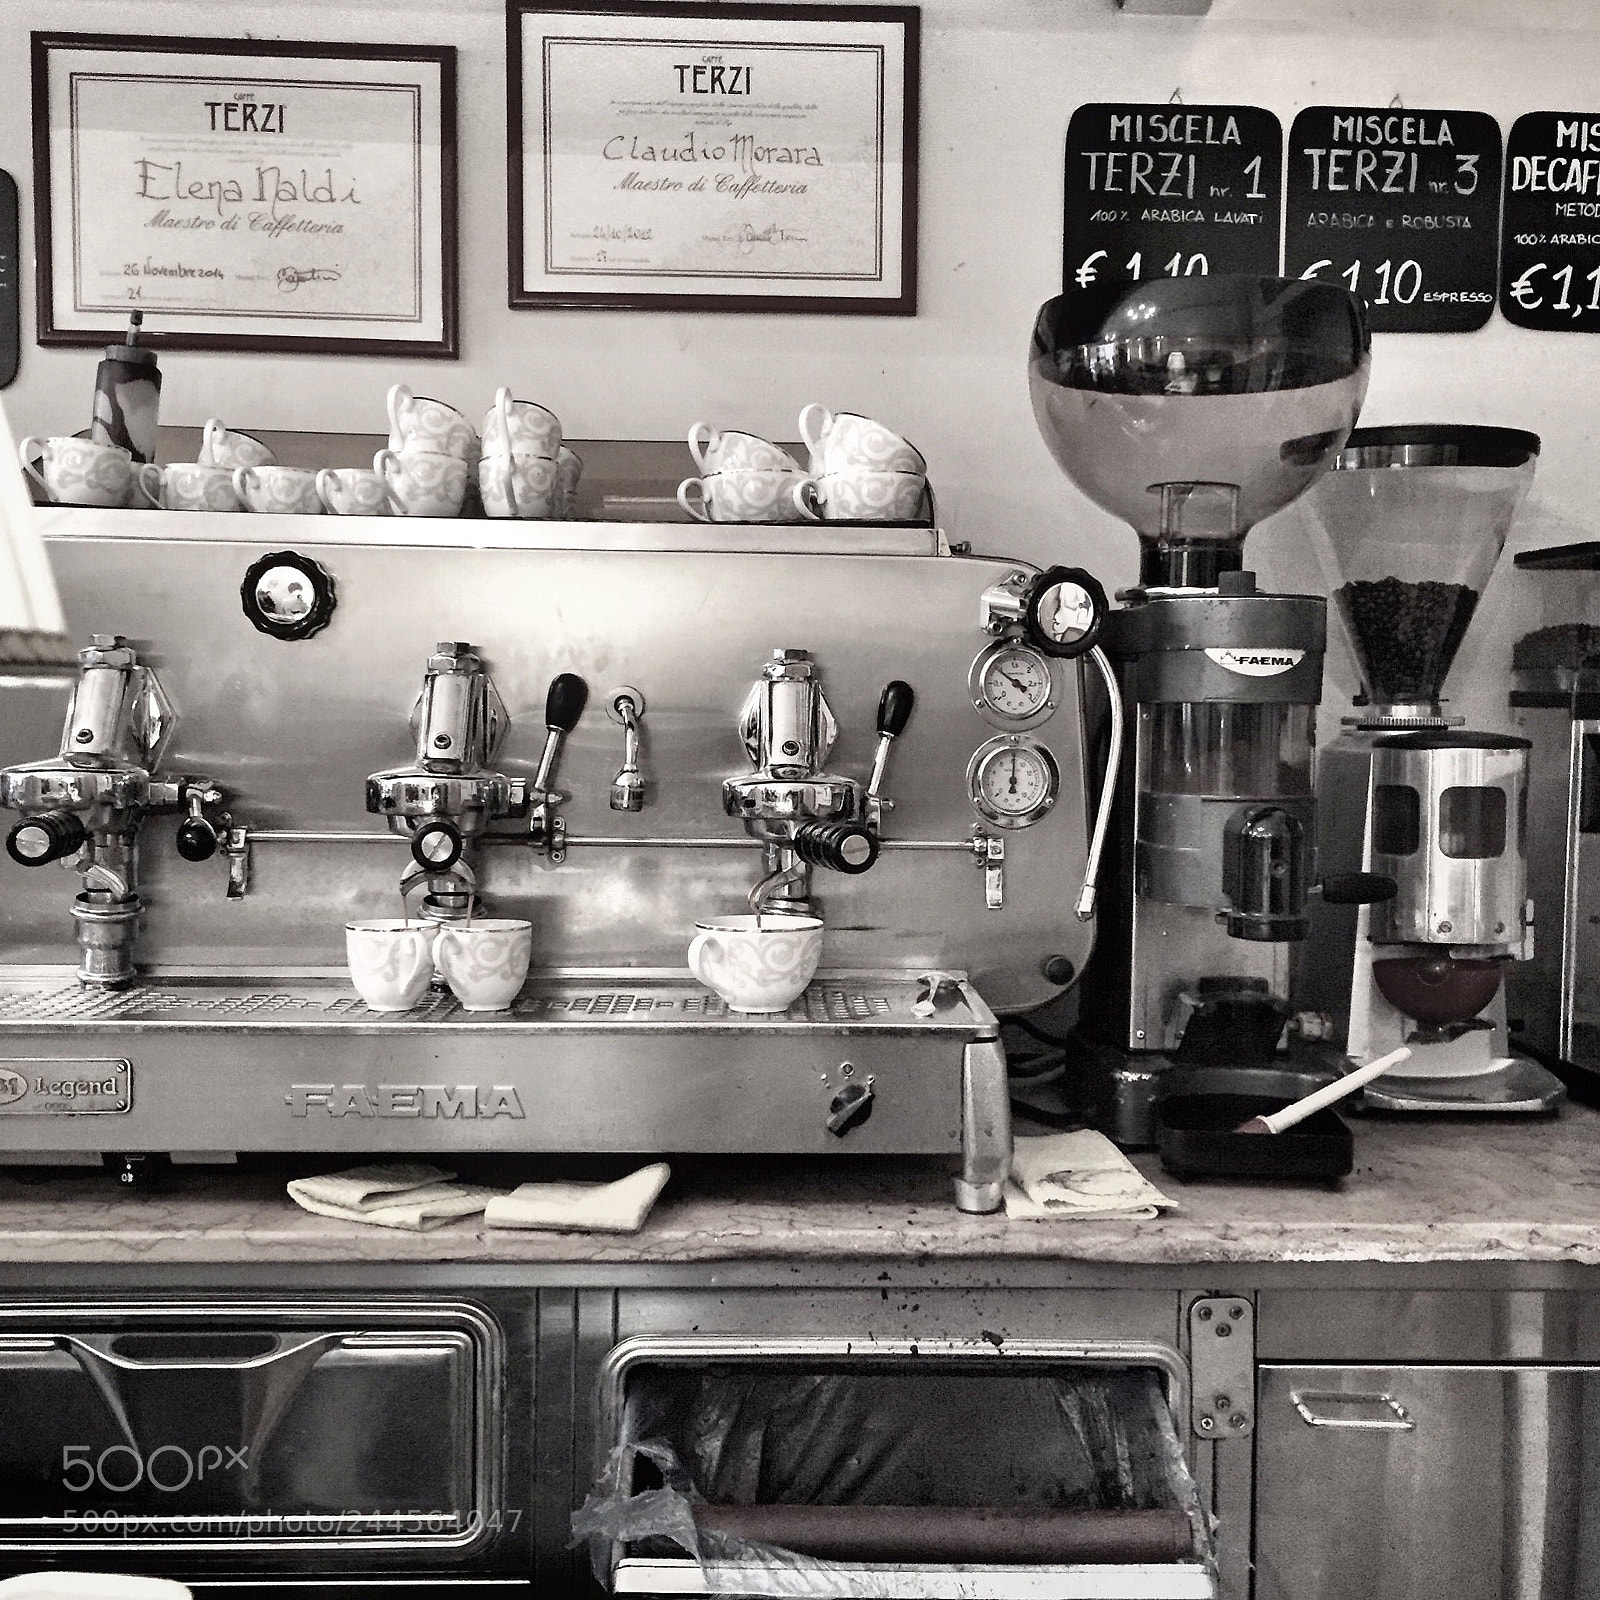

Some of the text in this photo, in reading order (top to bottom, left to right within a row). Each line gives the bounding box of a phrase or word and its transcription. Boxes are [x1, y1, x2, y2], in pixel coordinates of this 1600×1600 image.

[673, 64, 753, 95] TERZI
[204, 101, 287, 134] TERZI
[1109, 114, 1242, 146] MISCELA
[1333, 115, 1455, 147] MISCELA
[602, 131, 824, 176] Claudio Morara
[134, 157, 243, 217] Elena
[613, 171, 808, 200] Maestro di Caffetteria
[1081, 152, 1196, 199] TERZI
[1243, 155, 1266, 199] 1
[1304, 148, 1419, 193] TERZI
[1454, 154, 1480, 195] 3
[143, 208, 344, 238] Maestro di Caffetteria
[1141, 209, 1205, 223] ARABICA
[1307, 212, 1375, 229] ARABICA
[1401, 214, 1473, 229] ROBUSTA
[1513, 233, 1547, 245] 100%
[1423, 292, 1493, 303] ESPRESSO
[1509, 263, 1548, 310] €
[1236, 656, 1294, 666] FAEMA
[34, 1077, 119, 1099] Legend
[285, 1084, 526, 1119] FAEMA
